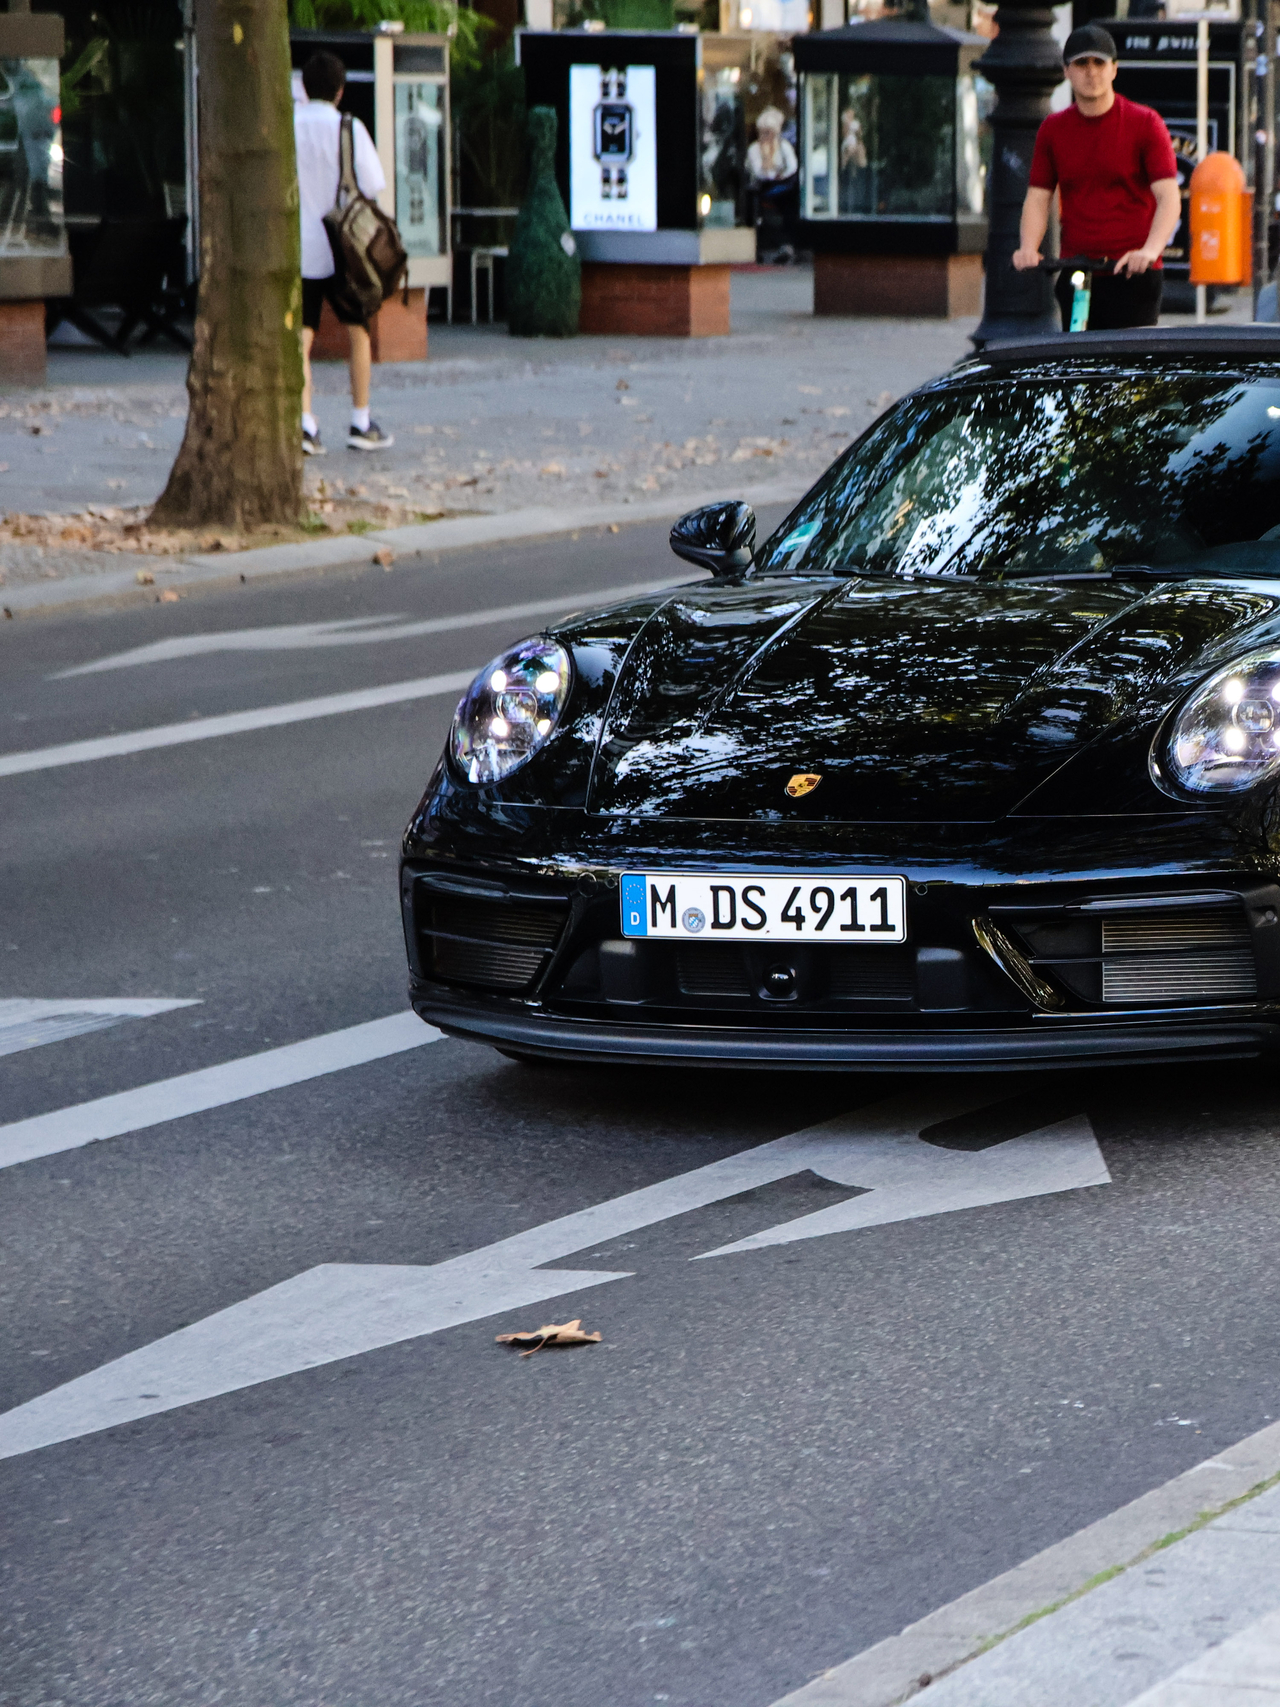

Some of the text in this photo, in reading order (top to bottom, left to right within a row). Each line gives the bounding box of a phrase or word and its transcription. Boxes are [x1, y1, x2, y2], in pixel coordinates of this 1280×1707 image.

[583, 211, 646, 226] CHANEL
[650, 884, 896, 932] M DS 4911
[630, 911, 641, 926] D
